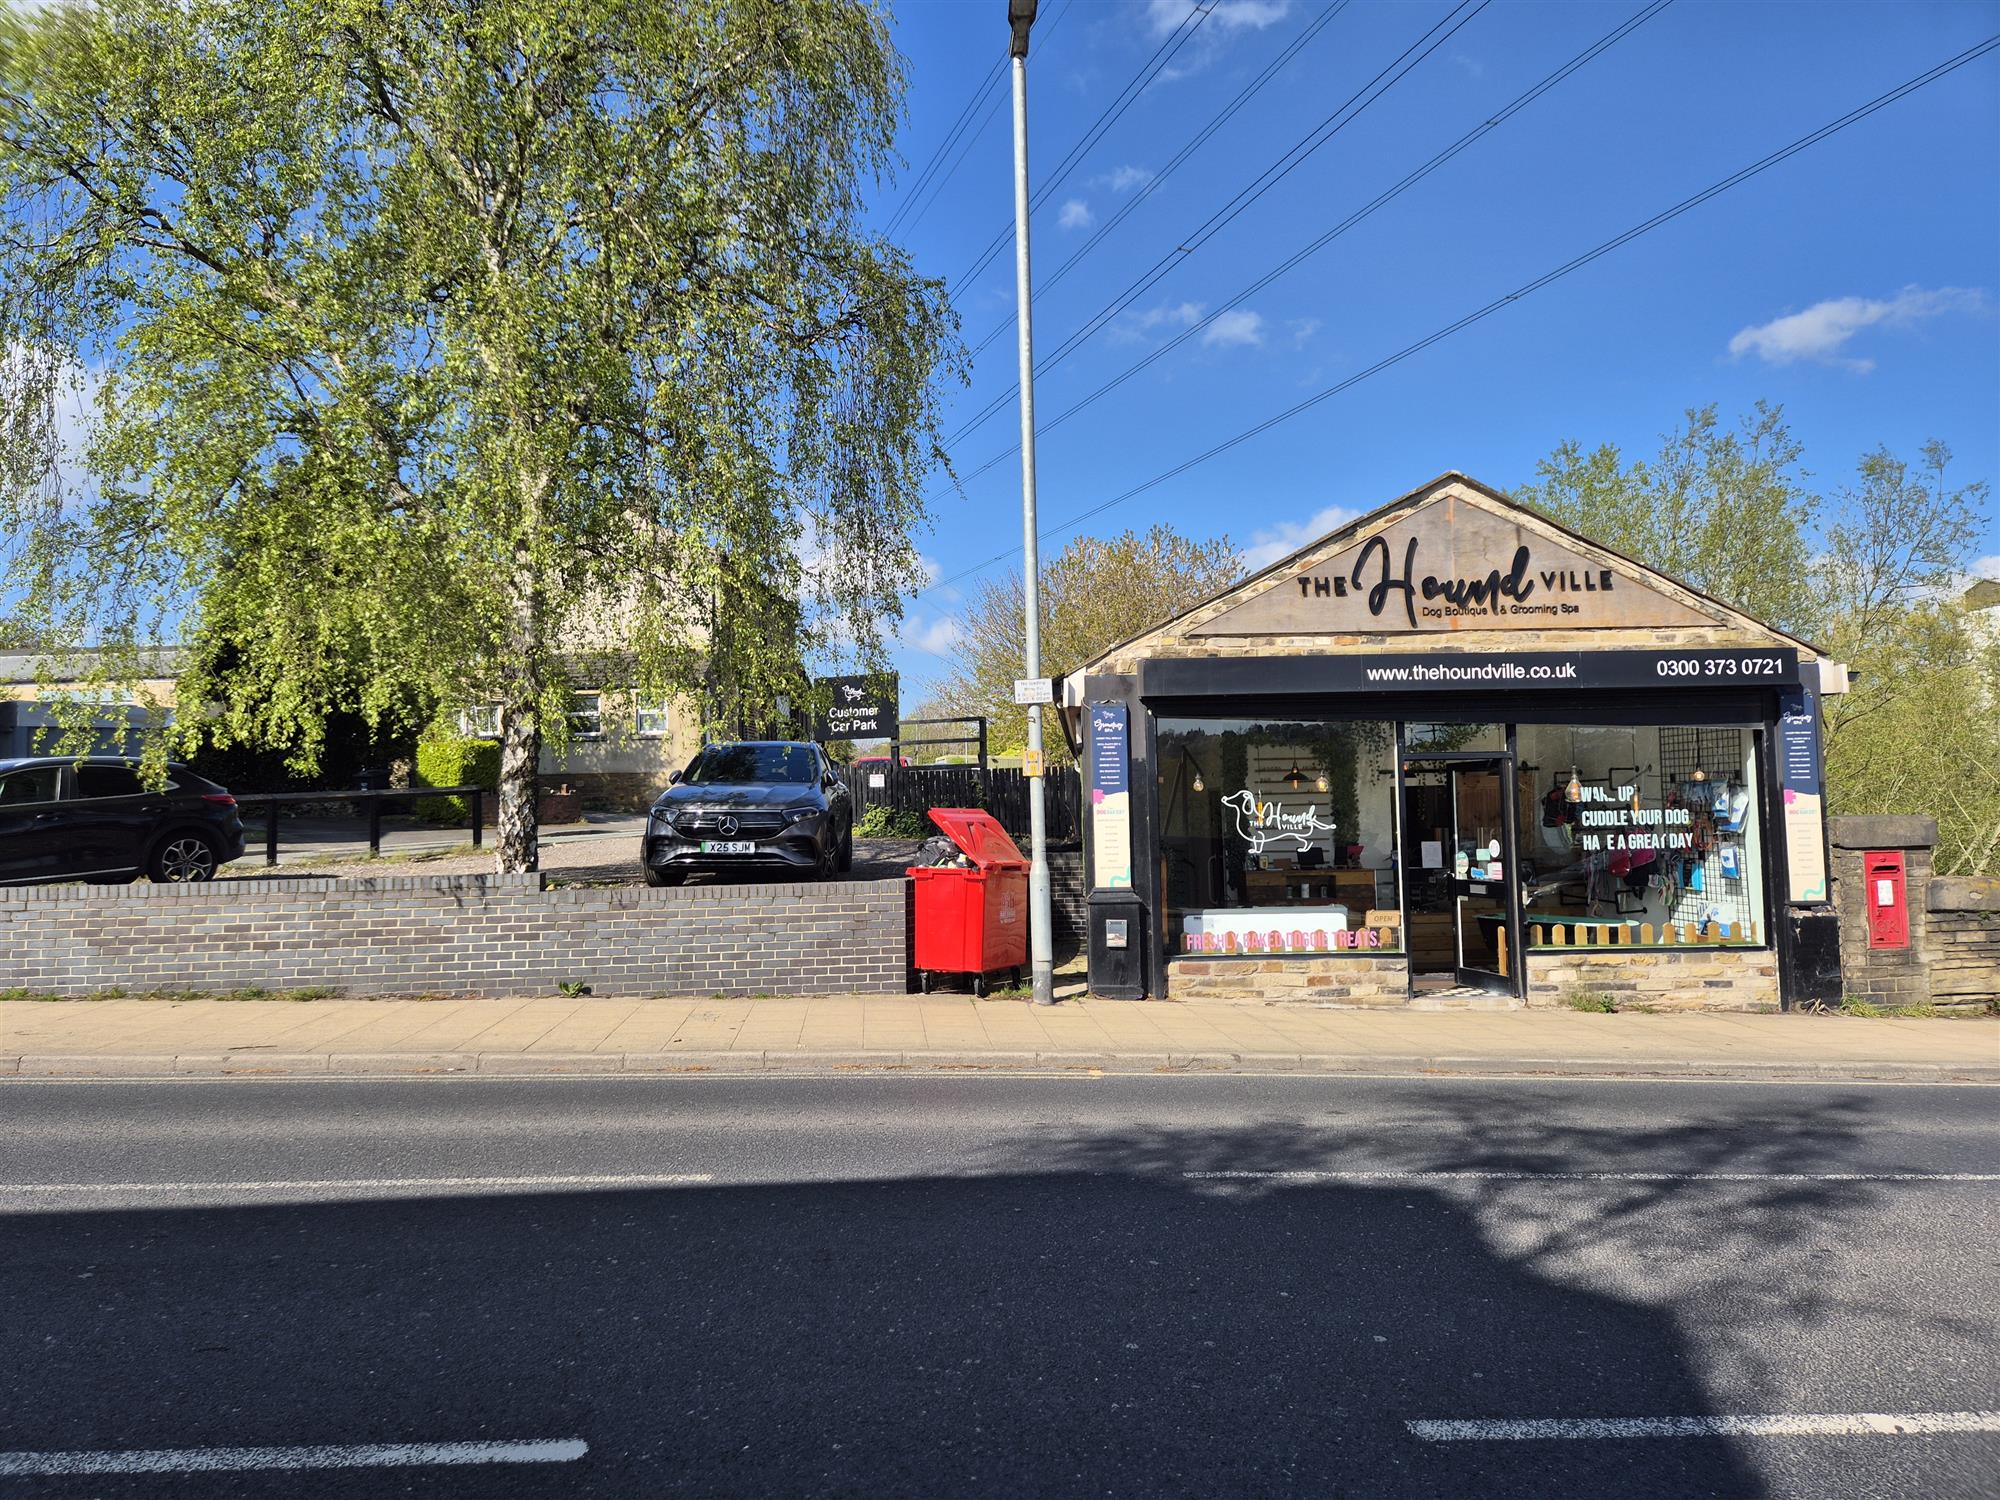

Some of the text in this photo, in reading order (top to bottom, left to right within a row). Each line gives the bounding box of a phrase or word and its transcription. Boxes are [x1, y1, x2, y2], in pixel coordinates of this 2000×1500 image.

[1297, 536, 1614, 628] THE Hound VILLE
[1422, 603, 1580, 619] Dog Boutique & Grooming Spa
[1367, 661, 1577, 682] www.thehoundville.co.uk
[1656, 658, 1783, 677] 0300 373 0721
[829, 707, 879, 718] Customer
[831, 719, 878, 732] Car Park
[1618, 785, 1635, 802] UP
[1262, 801, 1316, 831] Hound
[1581, 808, 1690, 826] CUDDLE YOUR DOG
[710, 842, 751, 852] X25 SJM
[1583, 834, 1615, 850] HAE
[1617, 834, 1626, 850] A
[1669, 832, 1693, 849] DAY
[1186, 932, 1239, 950] FRESHLY
[1243, 931, 1282, 948] BAKED
